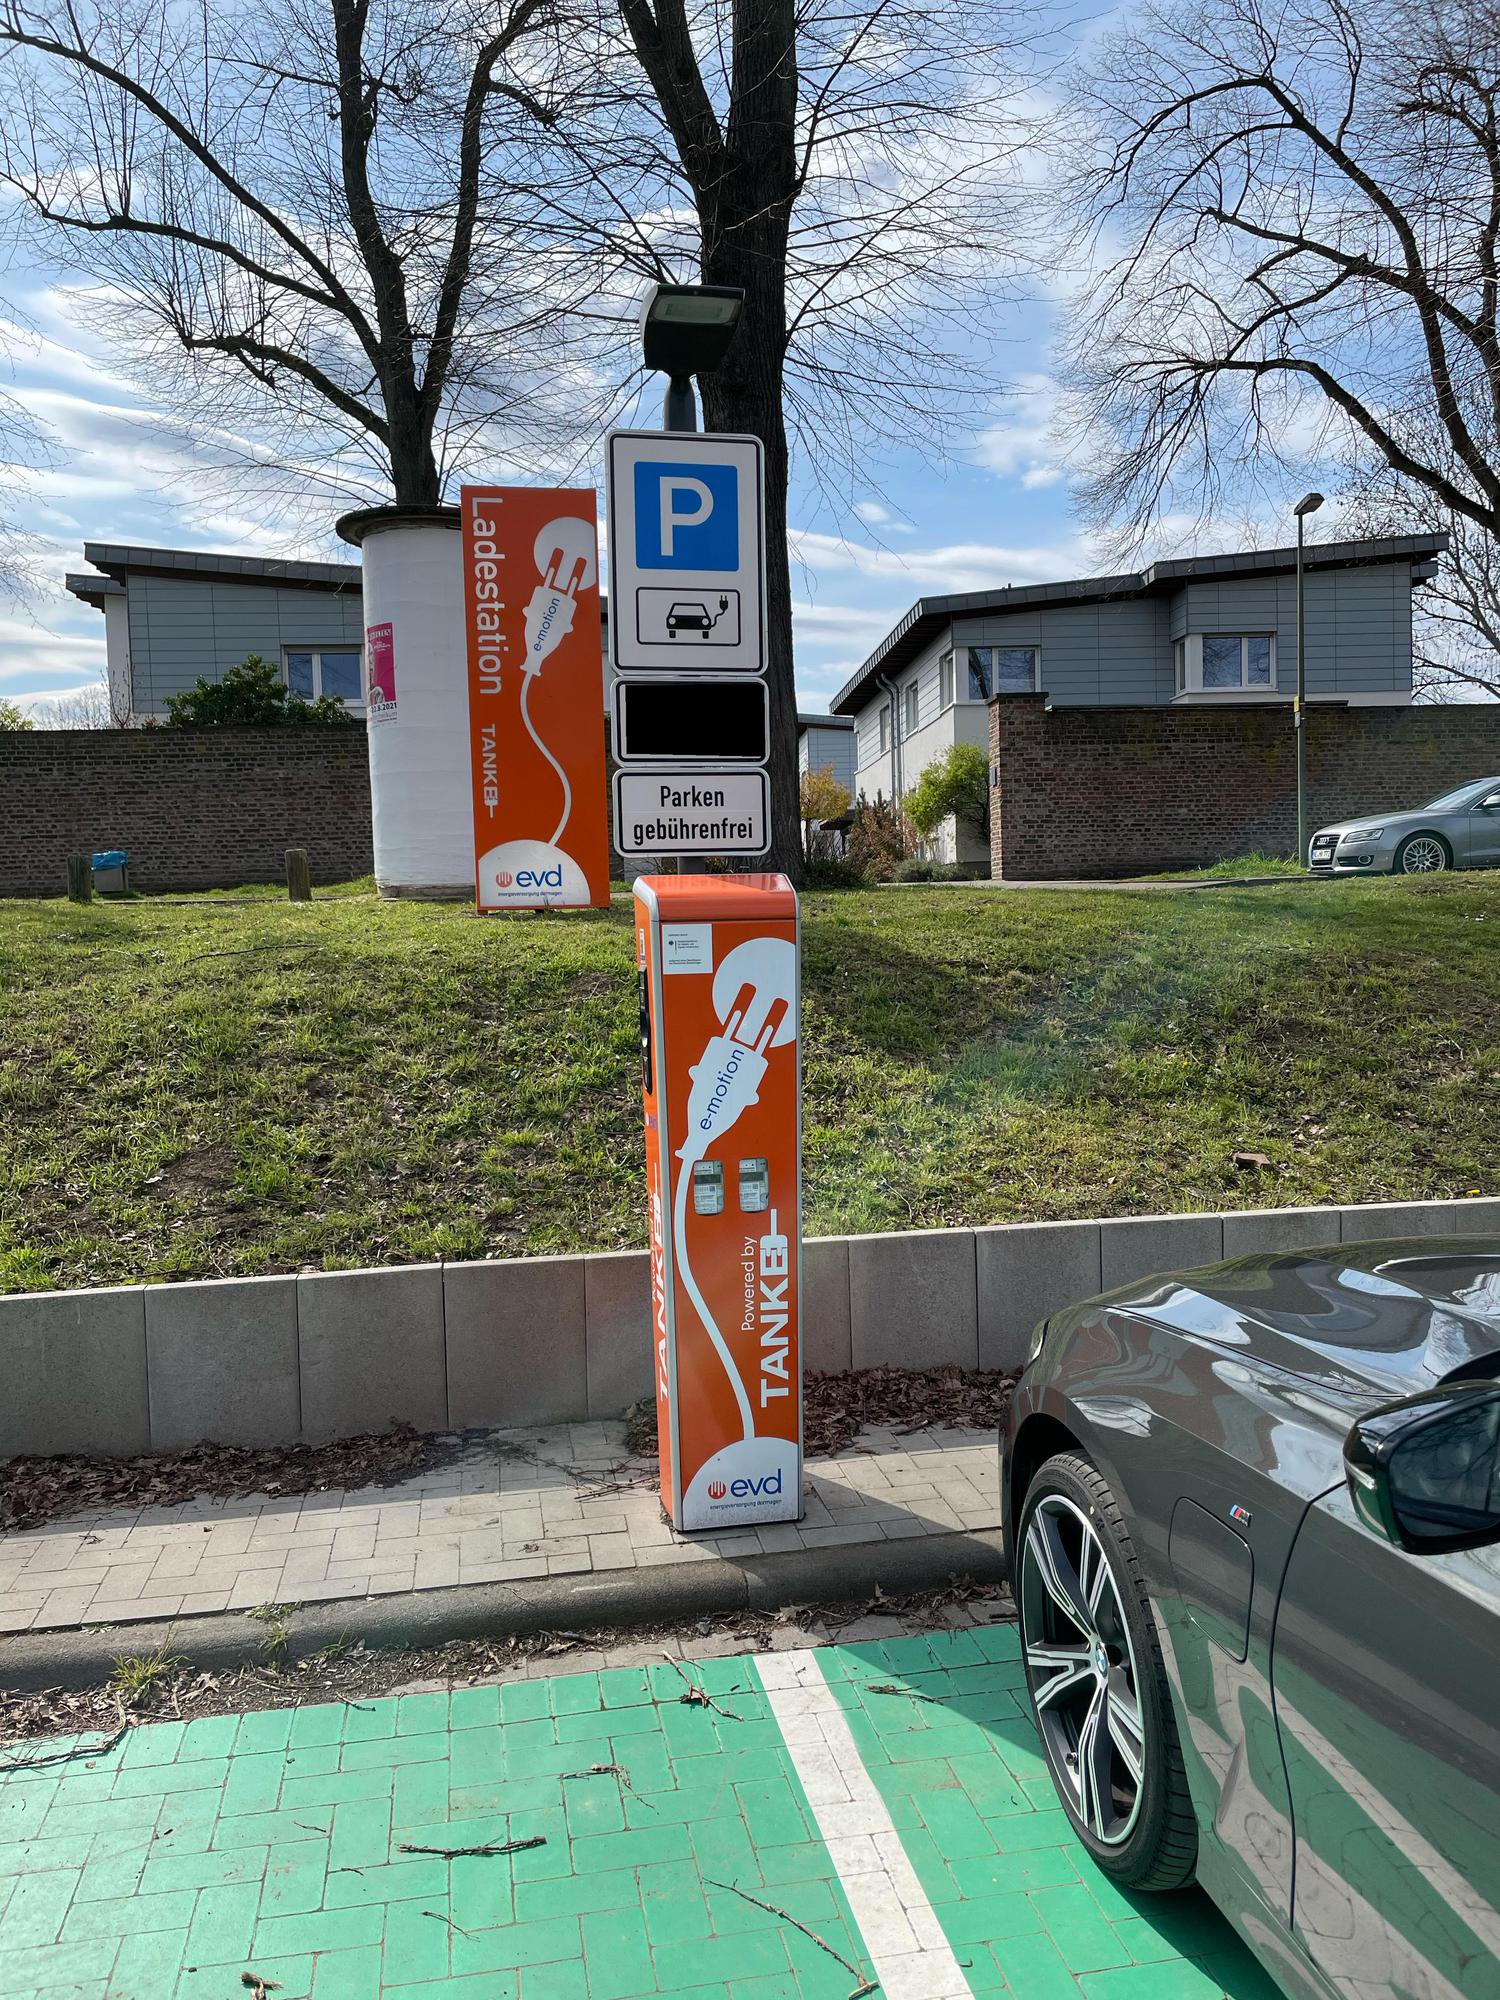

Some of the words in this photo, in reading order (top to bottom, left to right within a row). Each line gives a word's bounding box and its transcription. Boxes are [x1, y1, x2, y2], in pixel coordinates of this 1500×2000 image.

[659, 476, 714, 556] P
[472, 497, 506, 694] Ladestation
[533, 596, 560, 652] e-motion
[660, 786, 724, 807] Parken
[633, 817, 753, 845] gebührenfrei
[516, 864, 562, 887] evd
[700, 1050, 744, 1131] e-motion
[744, 1236, 757, 1257] by
[741, 1259, 755, 1331] Powered
[730, 1468, 782, 1498] evd
